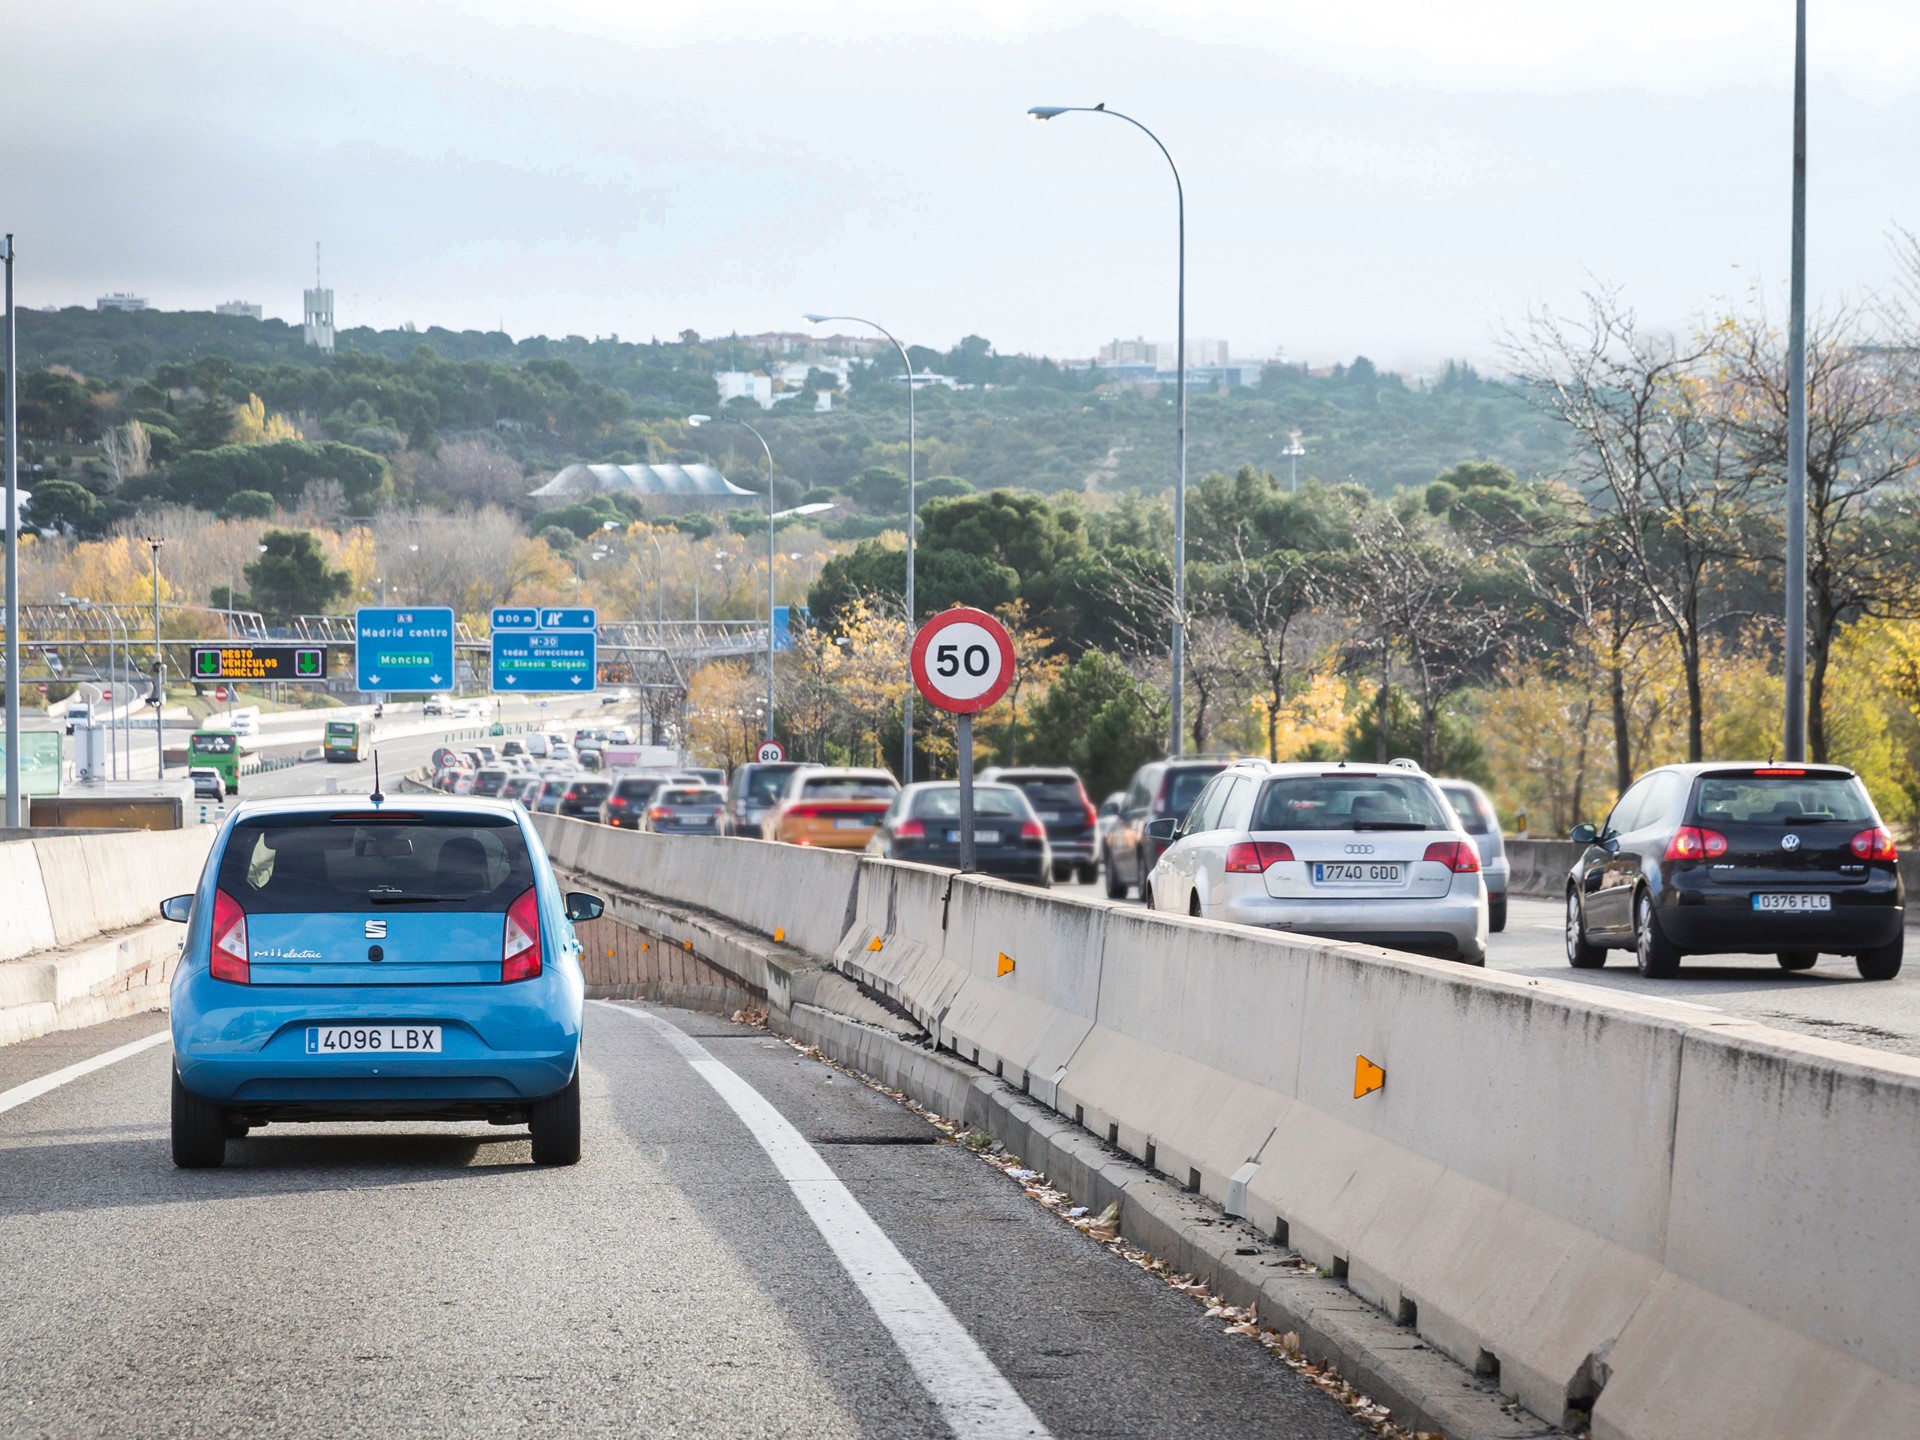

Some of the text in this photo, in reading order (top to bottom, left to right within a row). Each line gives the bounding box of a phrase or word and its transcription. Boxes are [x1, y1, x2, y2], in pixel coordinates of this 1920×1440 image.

[583, 615, 589, 623] 6
[362, 628, 448, 638] Madrid centro
[531, 637, 557, 647] M-30
[222, 649, 253, 659] RESTO
[222, 659, 278, 668] VEHICULOS
[381, 655, 430, 664] Moncloa
[937, 645, 990, 677] 50
[551, 661, 586, 669] Delgado
[222, 668, 266, 677] MONCLOA
[762, 750, 779, 760] 80
[1326, 866, 1399, 880] 7740 GDD
[1762, 895, 1797, 908] 0376
[282, 949, 322, 959] electric
[323, 1030, 435, 1050] 4096 LBX
